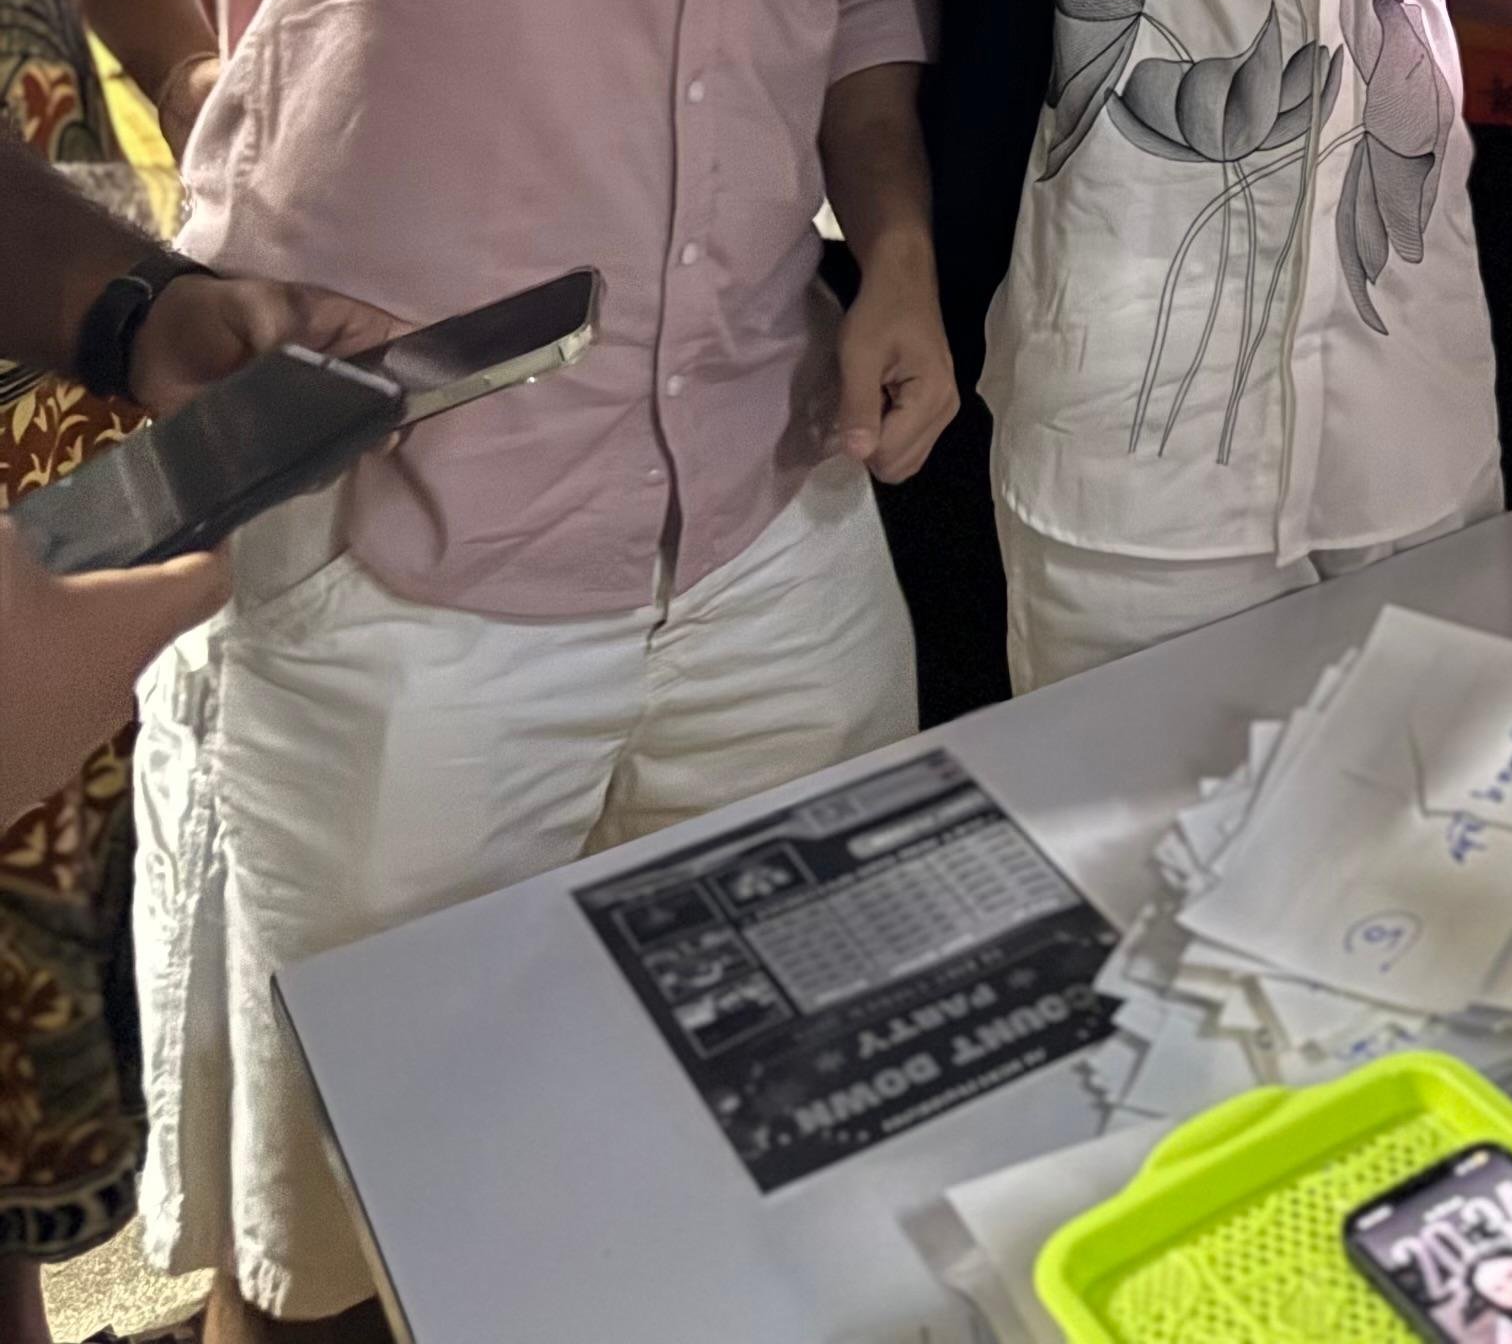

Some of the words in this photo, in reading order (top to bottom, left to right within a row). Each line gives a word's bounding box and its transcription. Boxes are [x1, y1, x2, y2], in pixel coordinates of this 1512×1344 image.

[857, 983, 996, 1059] PARTY
[951, 984, 1096, 1066] COUNT
[794, 1051, 941, 1134] DOWN
